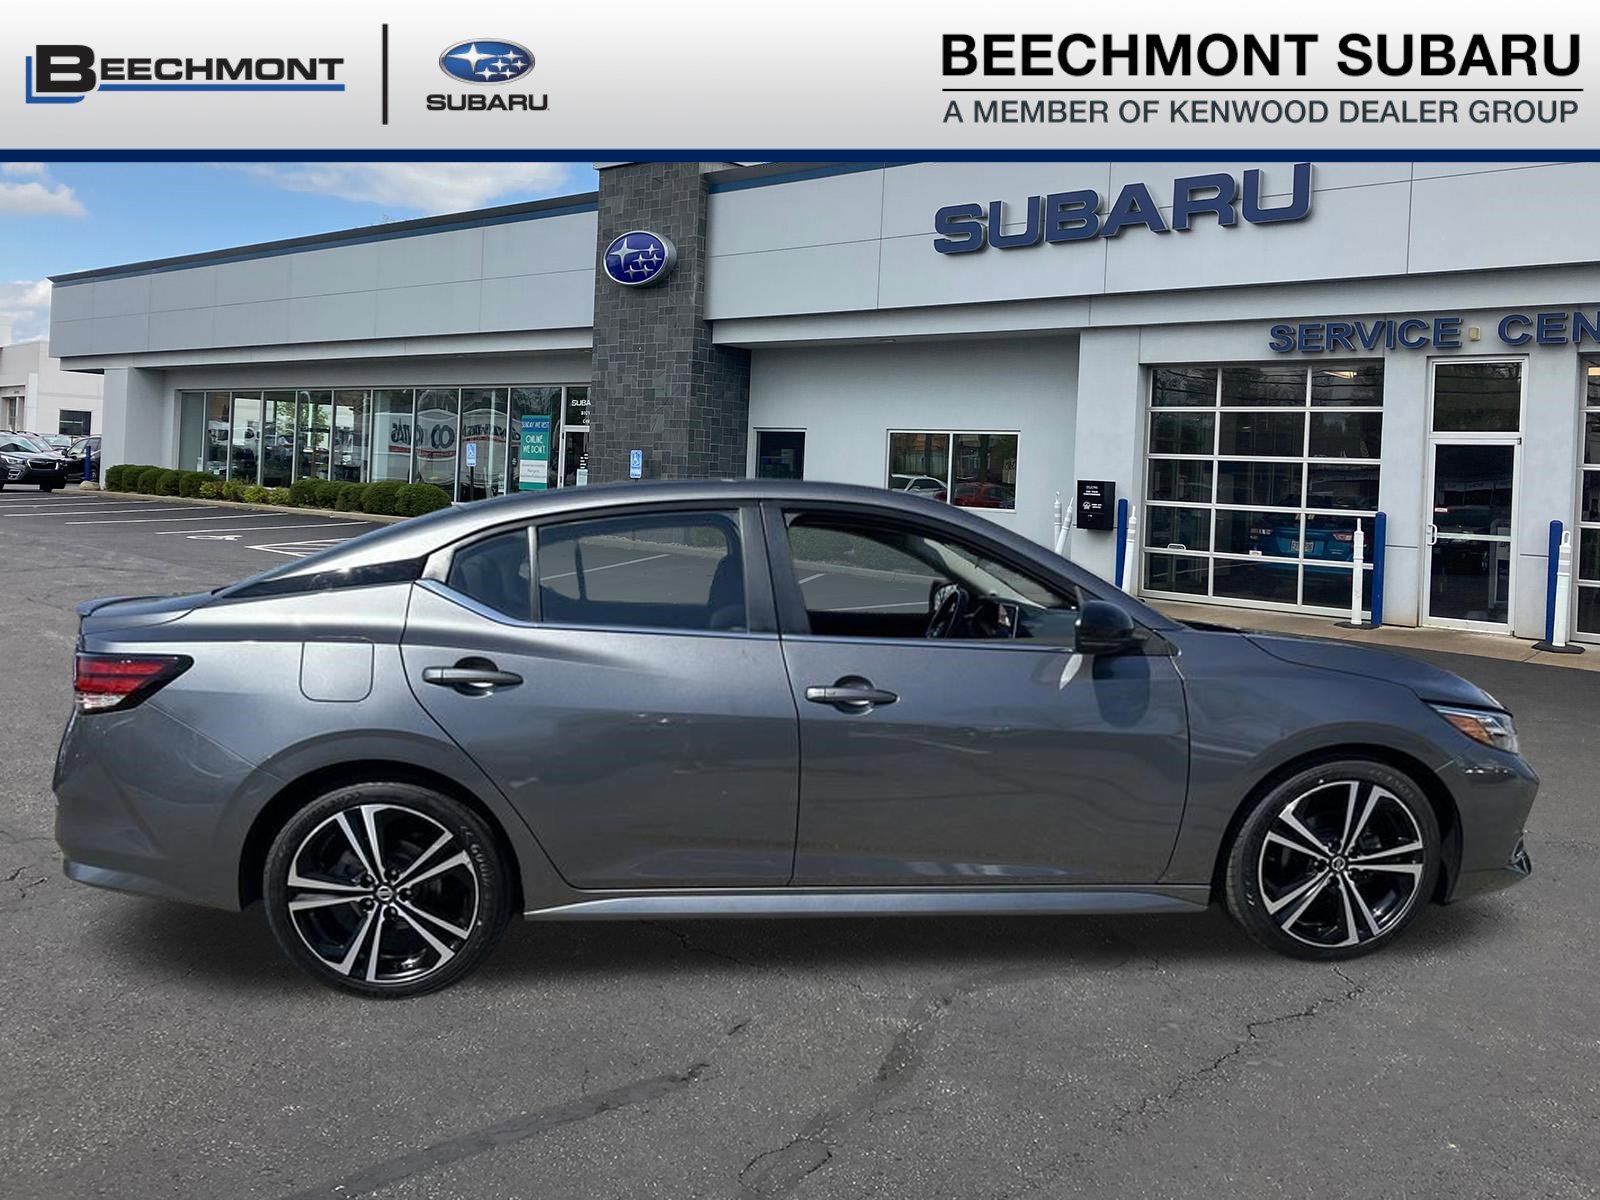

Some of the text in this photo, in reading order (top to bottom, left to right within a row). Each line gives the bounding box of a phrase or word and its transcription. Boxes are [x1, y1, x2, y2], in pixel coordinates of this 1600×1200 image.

[933, 162, 1314, 255] SUBARU
[1269, 311, 1600, 353] SERVICE CEN
